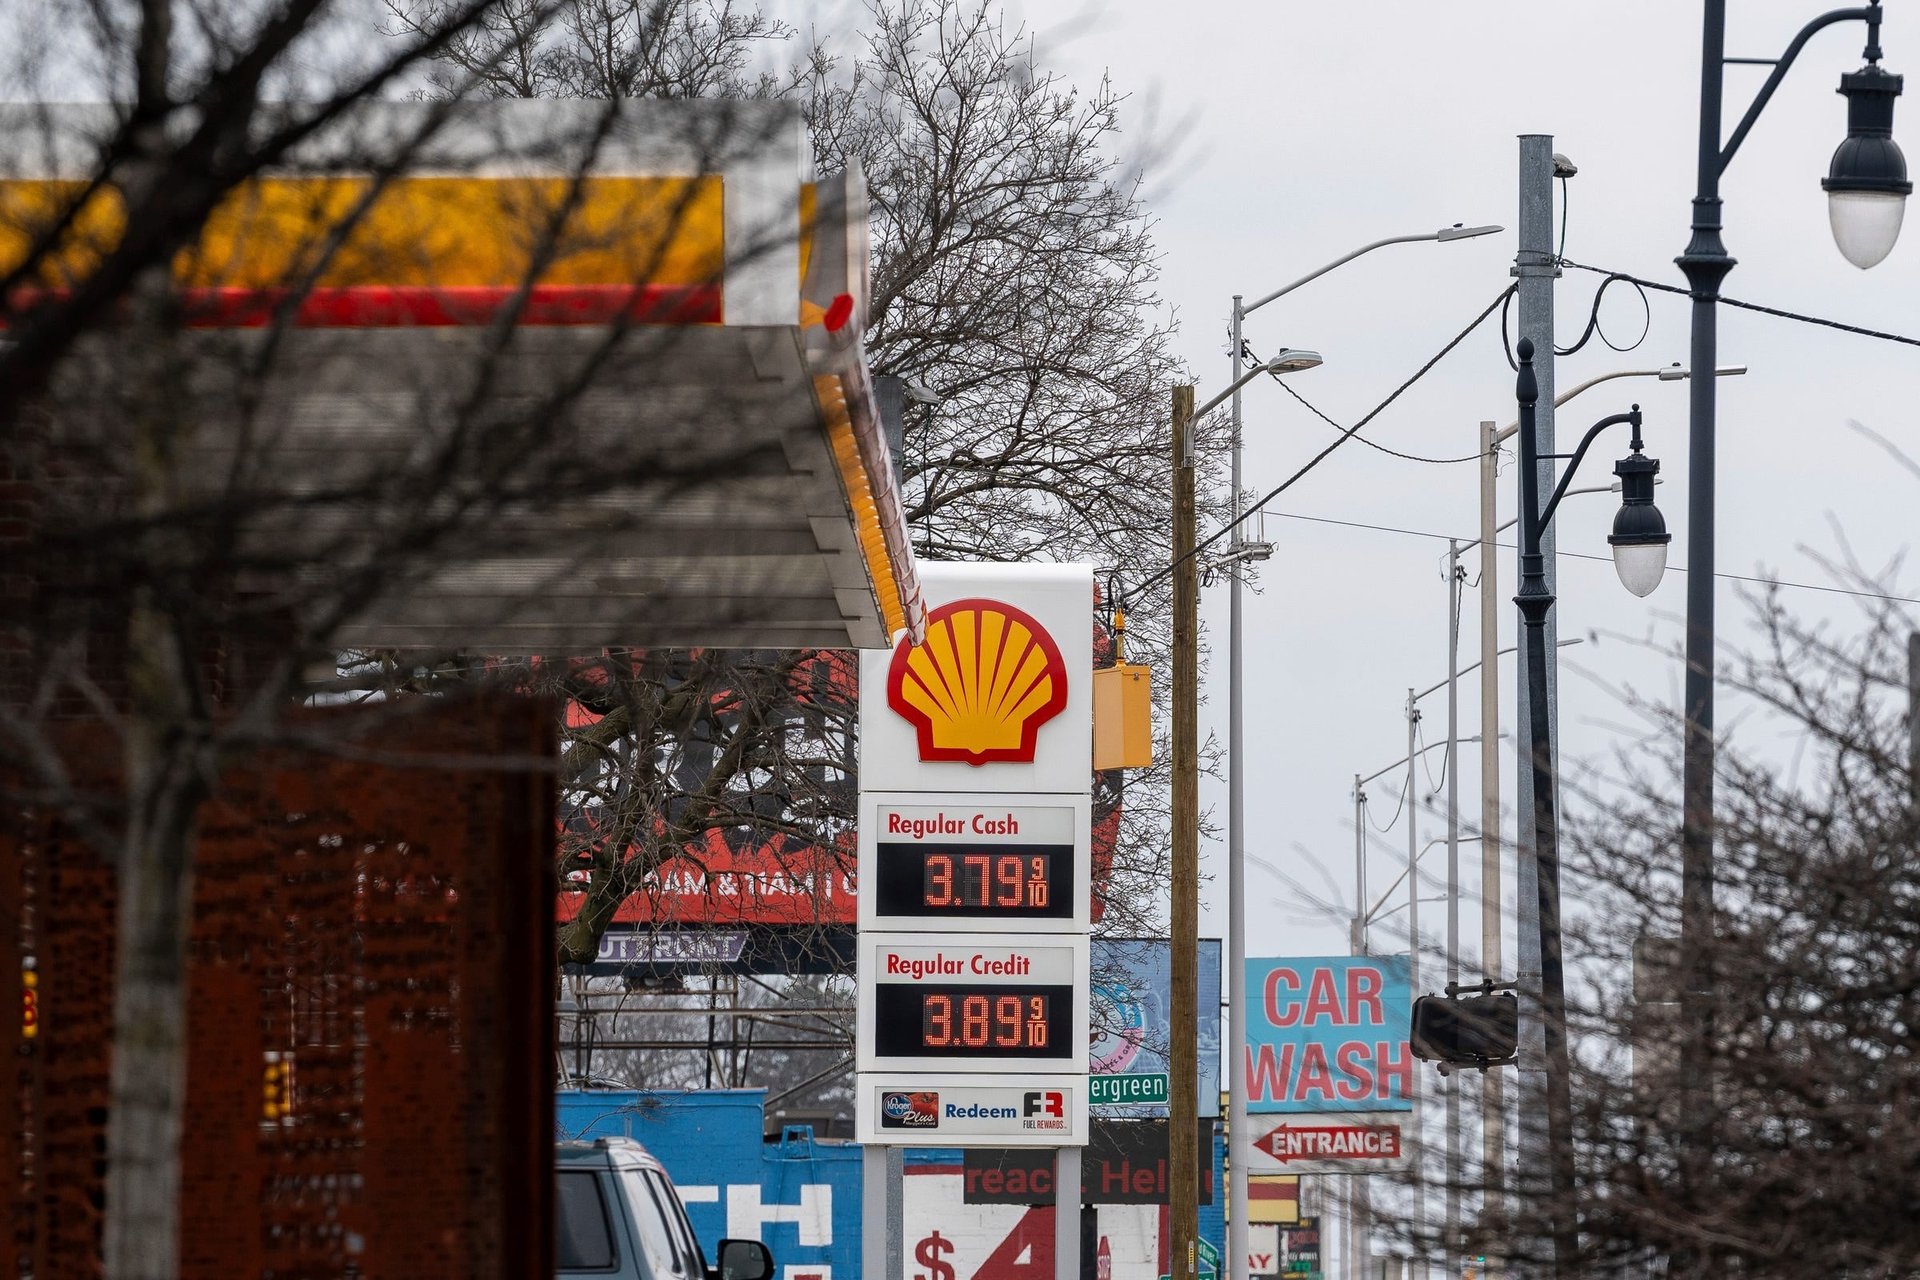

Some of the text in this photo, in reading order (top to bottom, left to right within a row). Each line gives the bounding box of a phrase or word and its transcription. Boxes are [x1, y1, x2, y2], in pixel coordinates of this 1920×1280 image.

[888, 813, 1019, 839] Regular Cash
[926, 855, 1023, 907] 3.79
[887, 953, 1030, 980] Regular Credit
[1263, 966, 1385, 1028] CAR
[925, 994, 1022, 1046] 3.89
[1246, 1040, 1412, 1102] WASH
[887, 1096, 911, 1115] Kroger
[903, 1110, 935, 1125] Plus
[946, 1103, 1017, 1118] Redeem
[1023, 1120, 1064, 1129] FUEL REWARDS
[1272, 1130, 1394, 1156] ENTRANCE
